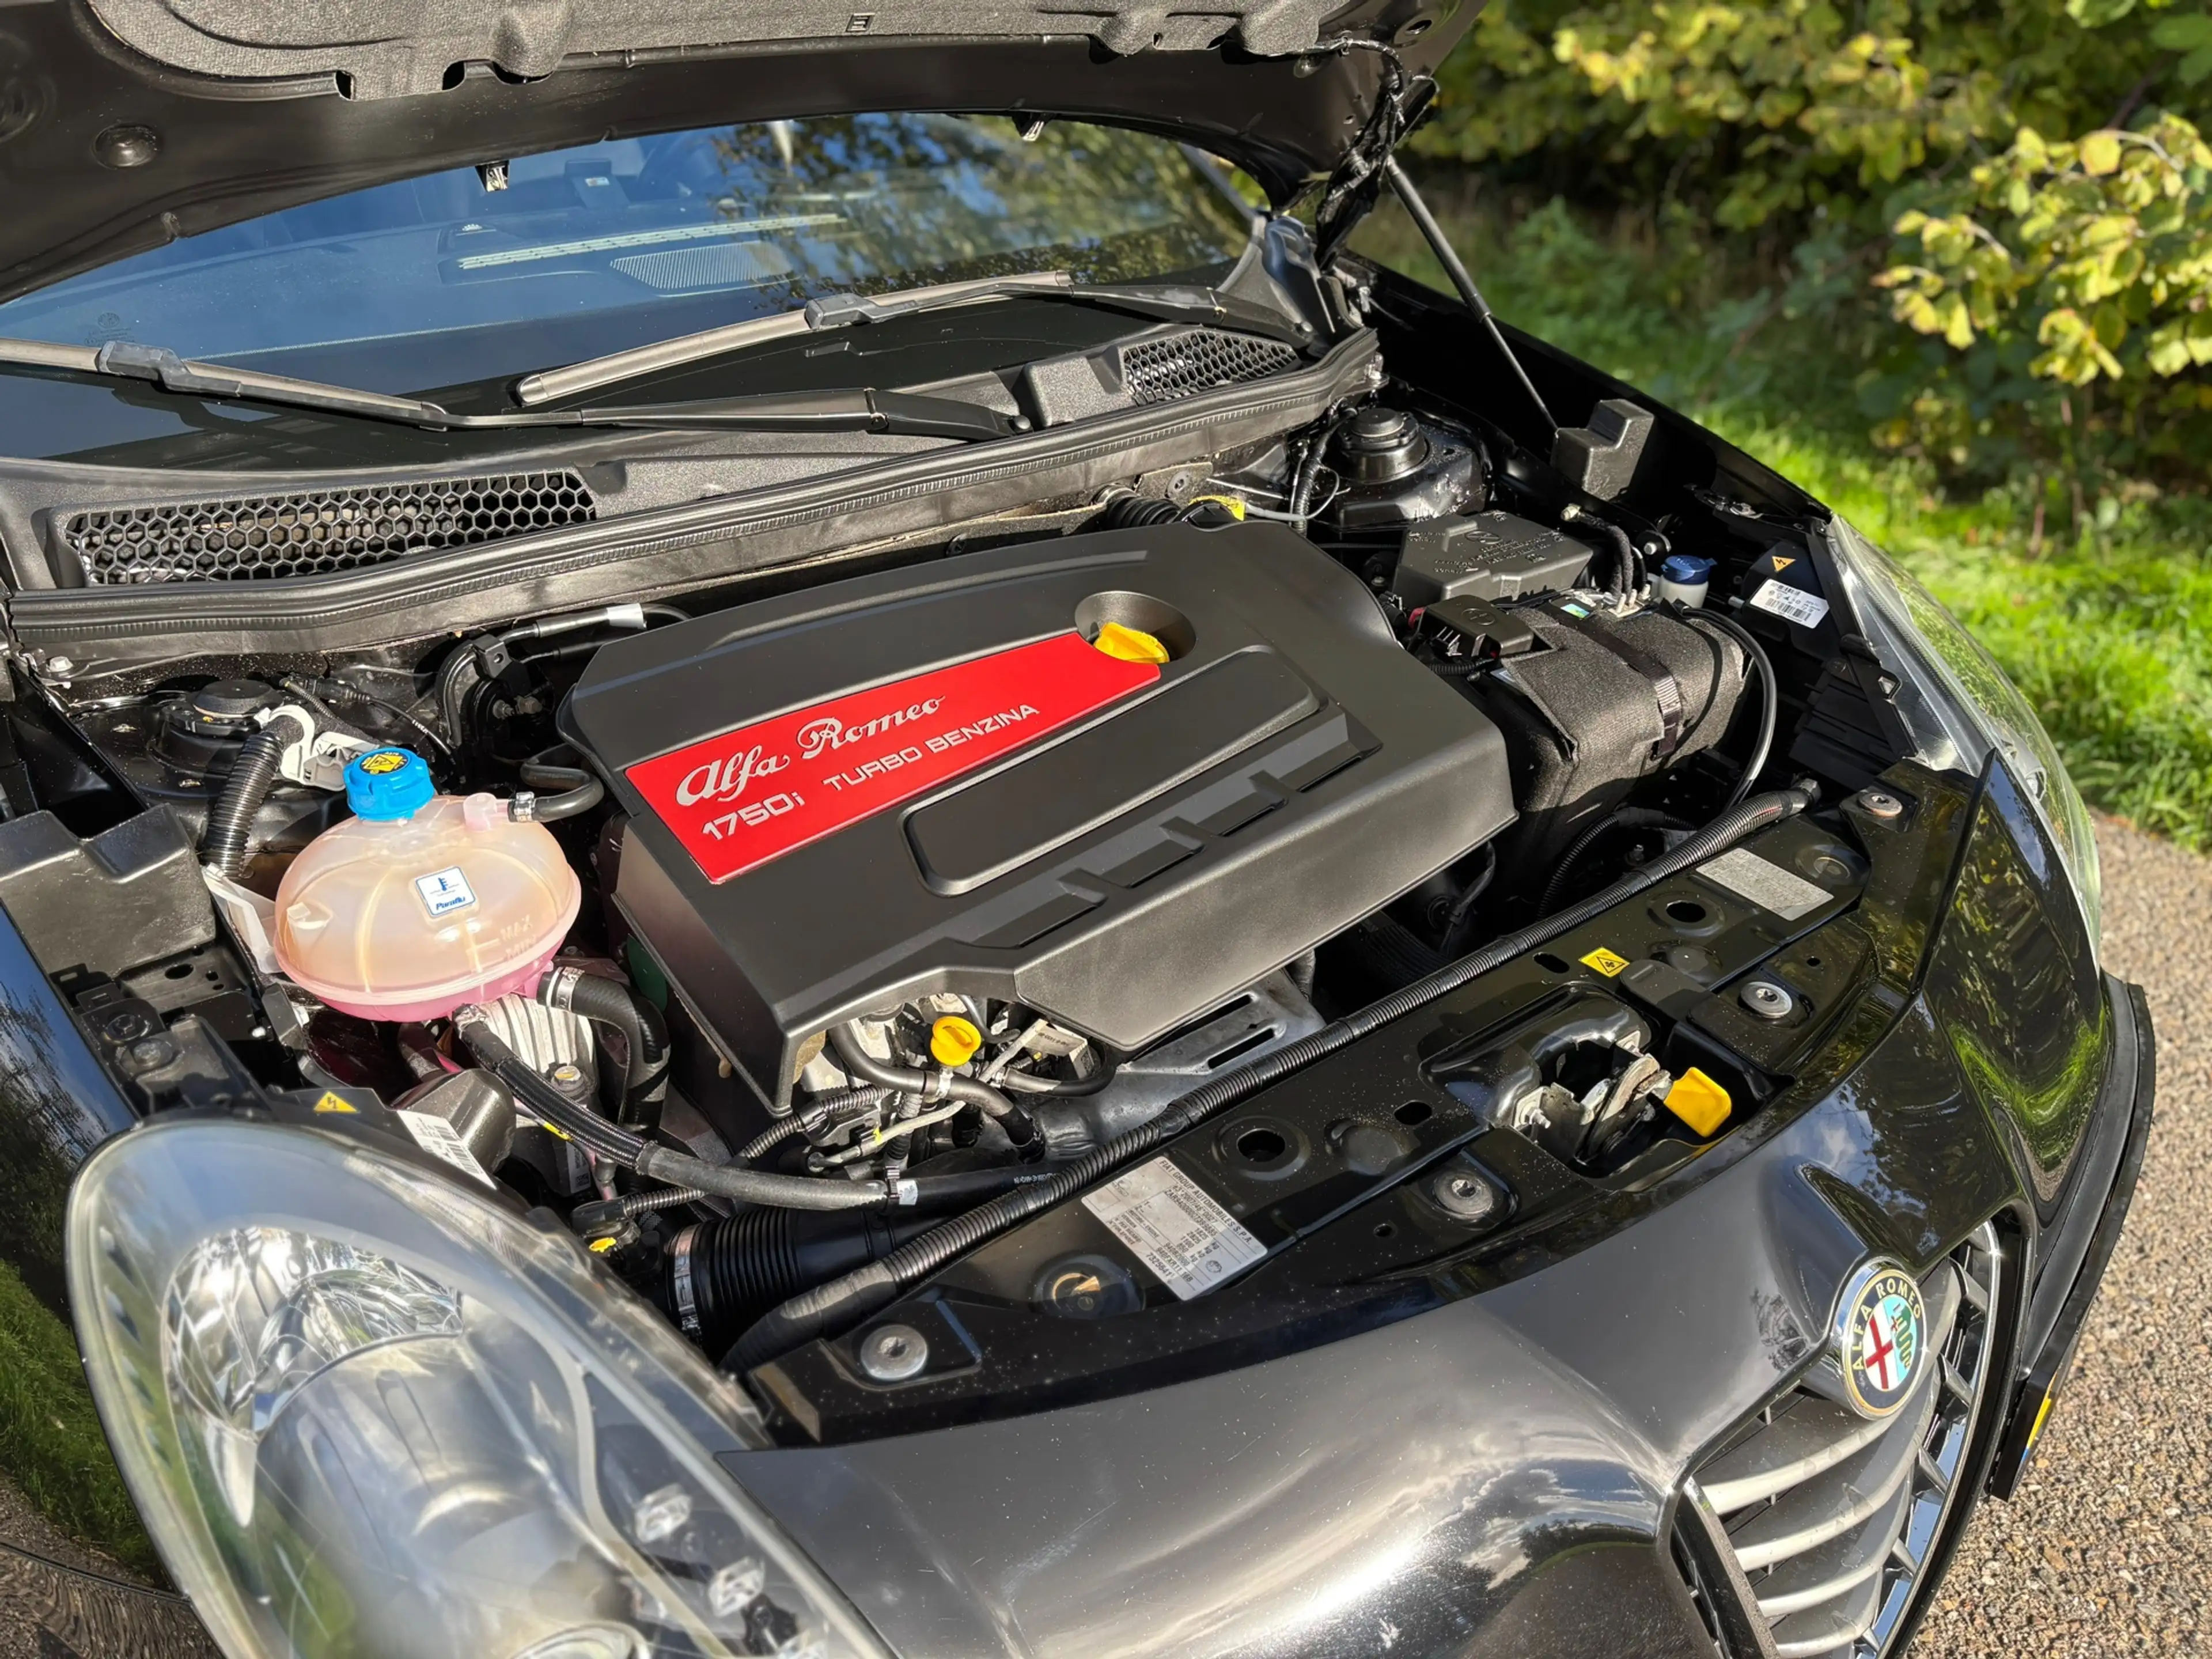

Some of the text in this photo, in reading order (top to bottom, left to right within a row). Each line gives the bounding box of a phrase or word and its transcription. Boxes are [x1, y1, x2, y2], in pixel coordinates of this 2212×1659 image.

[675, 696, 945, 807] Alfa Romeo
[702, 704, 1040, 840] 1750i TURBO BENZINA
[500, 914, 533, 941] MAX
[1158, 1160, 1255, 1244] FIAT GROUP AUTOMOBILES S.P.A.
[1851, 1278, 1921, 1371] ALFA ROMEO
